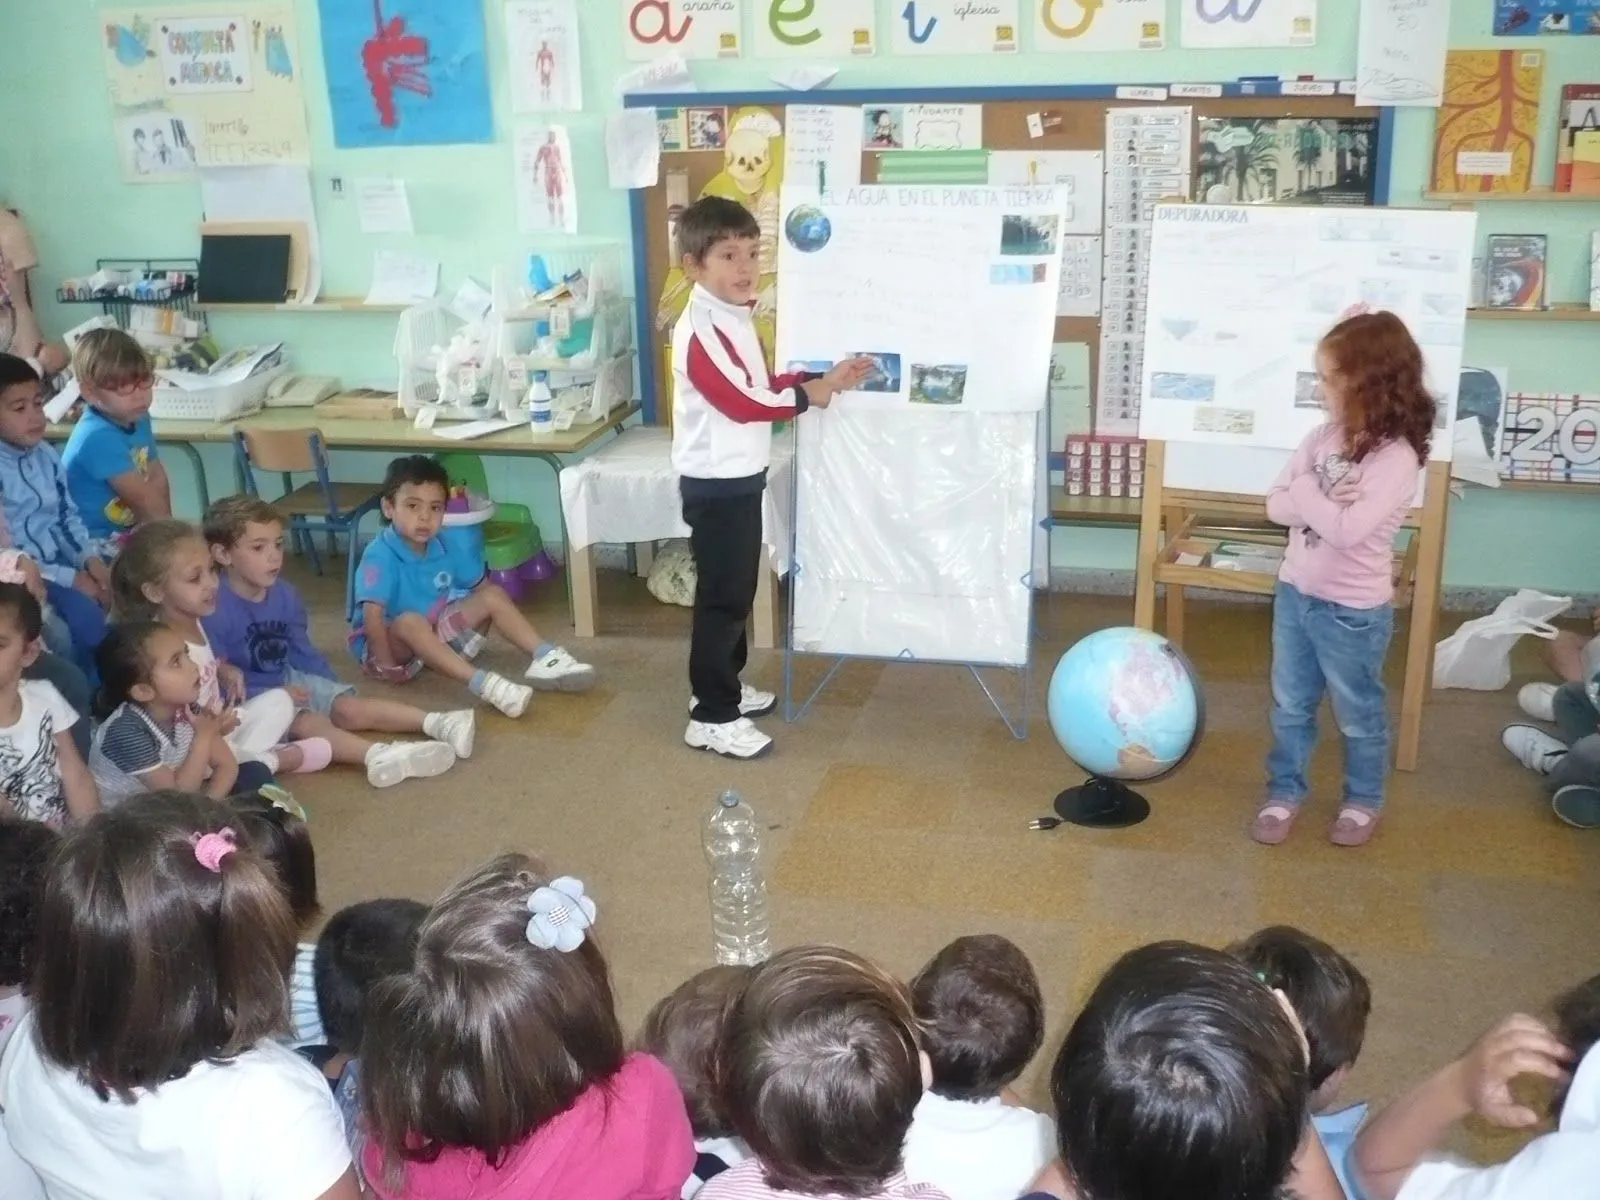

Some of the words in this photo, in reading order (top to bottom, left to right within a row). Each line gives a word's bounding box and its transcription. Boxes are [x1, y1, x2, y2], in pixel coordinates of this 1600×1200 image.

[954, 1, 1001, 20] iglesia
[769, 0, 821, 45] e
[168, 30, 235, 54] CONSULTA
[820, 189, 839, 206] EL
[846, 188, 891, 206] AGUA
[899, 188, 918, 207] EN
[921, 188, 937, 207] EL
[1004, 188, 1055, 209] TIERRA
[1158, 207, 1249, 223] DEPURADORA
